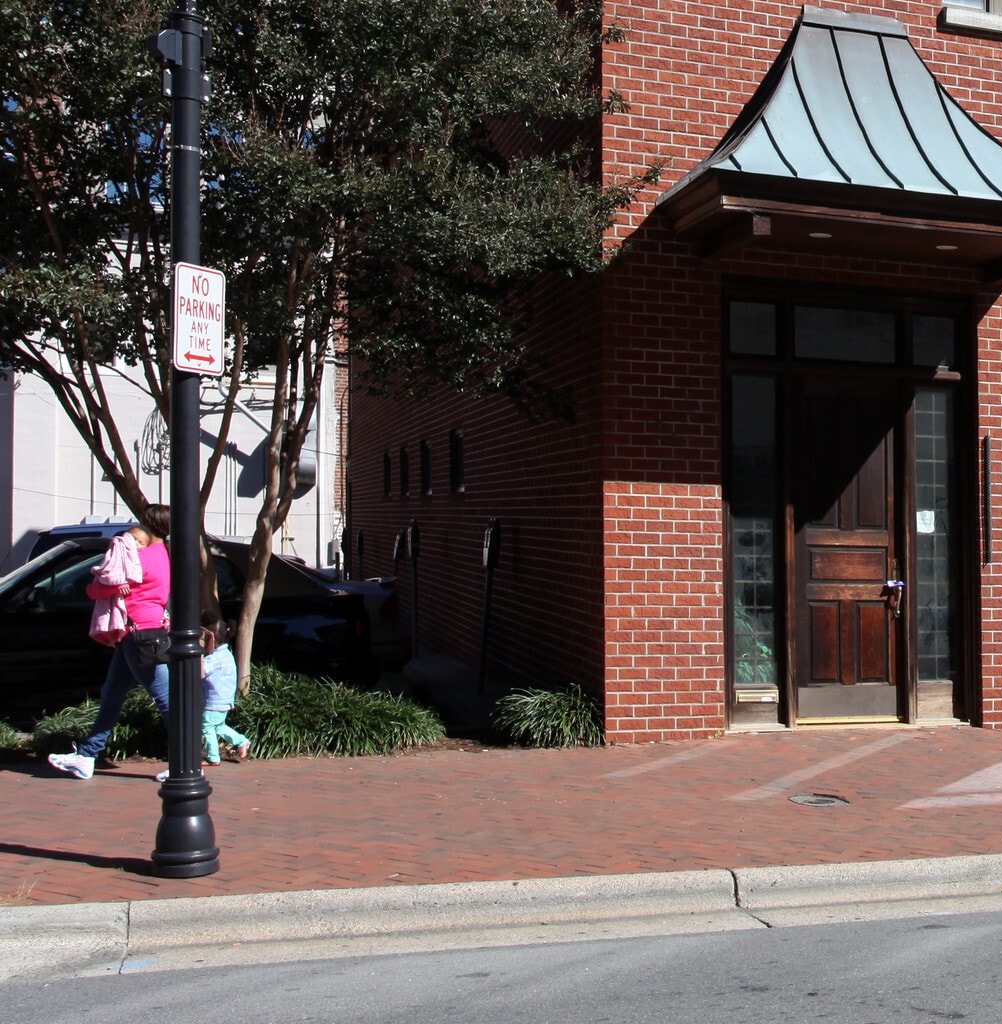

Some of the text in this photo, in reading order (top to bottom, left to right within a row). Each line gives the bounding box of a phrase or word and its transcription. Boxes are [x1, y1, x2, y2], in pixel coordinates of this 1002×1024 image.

[192, 275, 209, 297] NO
[179, 296, 221, 322] PARKING
[191, 321, 209, 335] ANY
[189, 335, 211, 351] TIME
